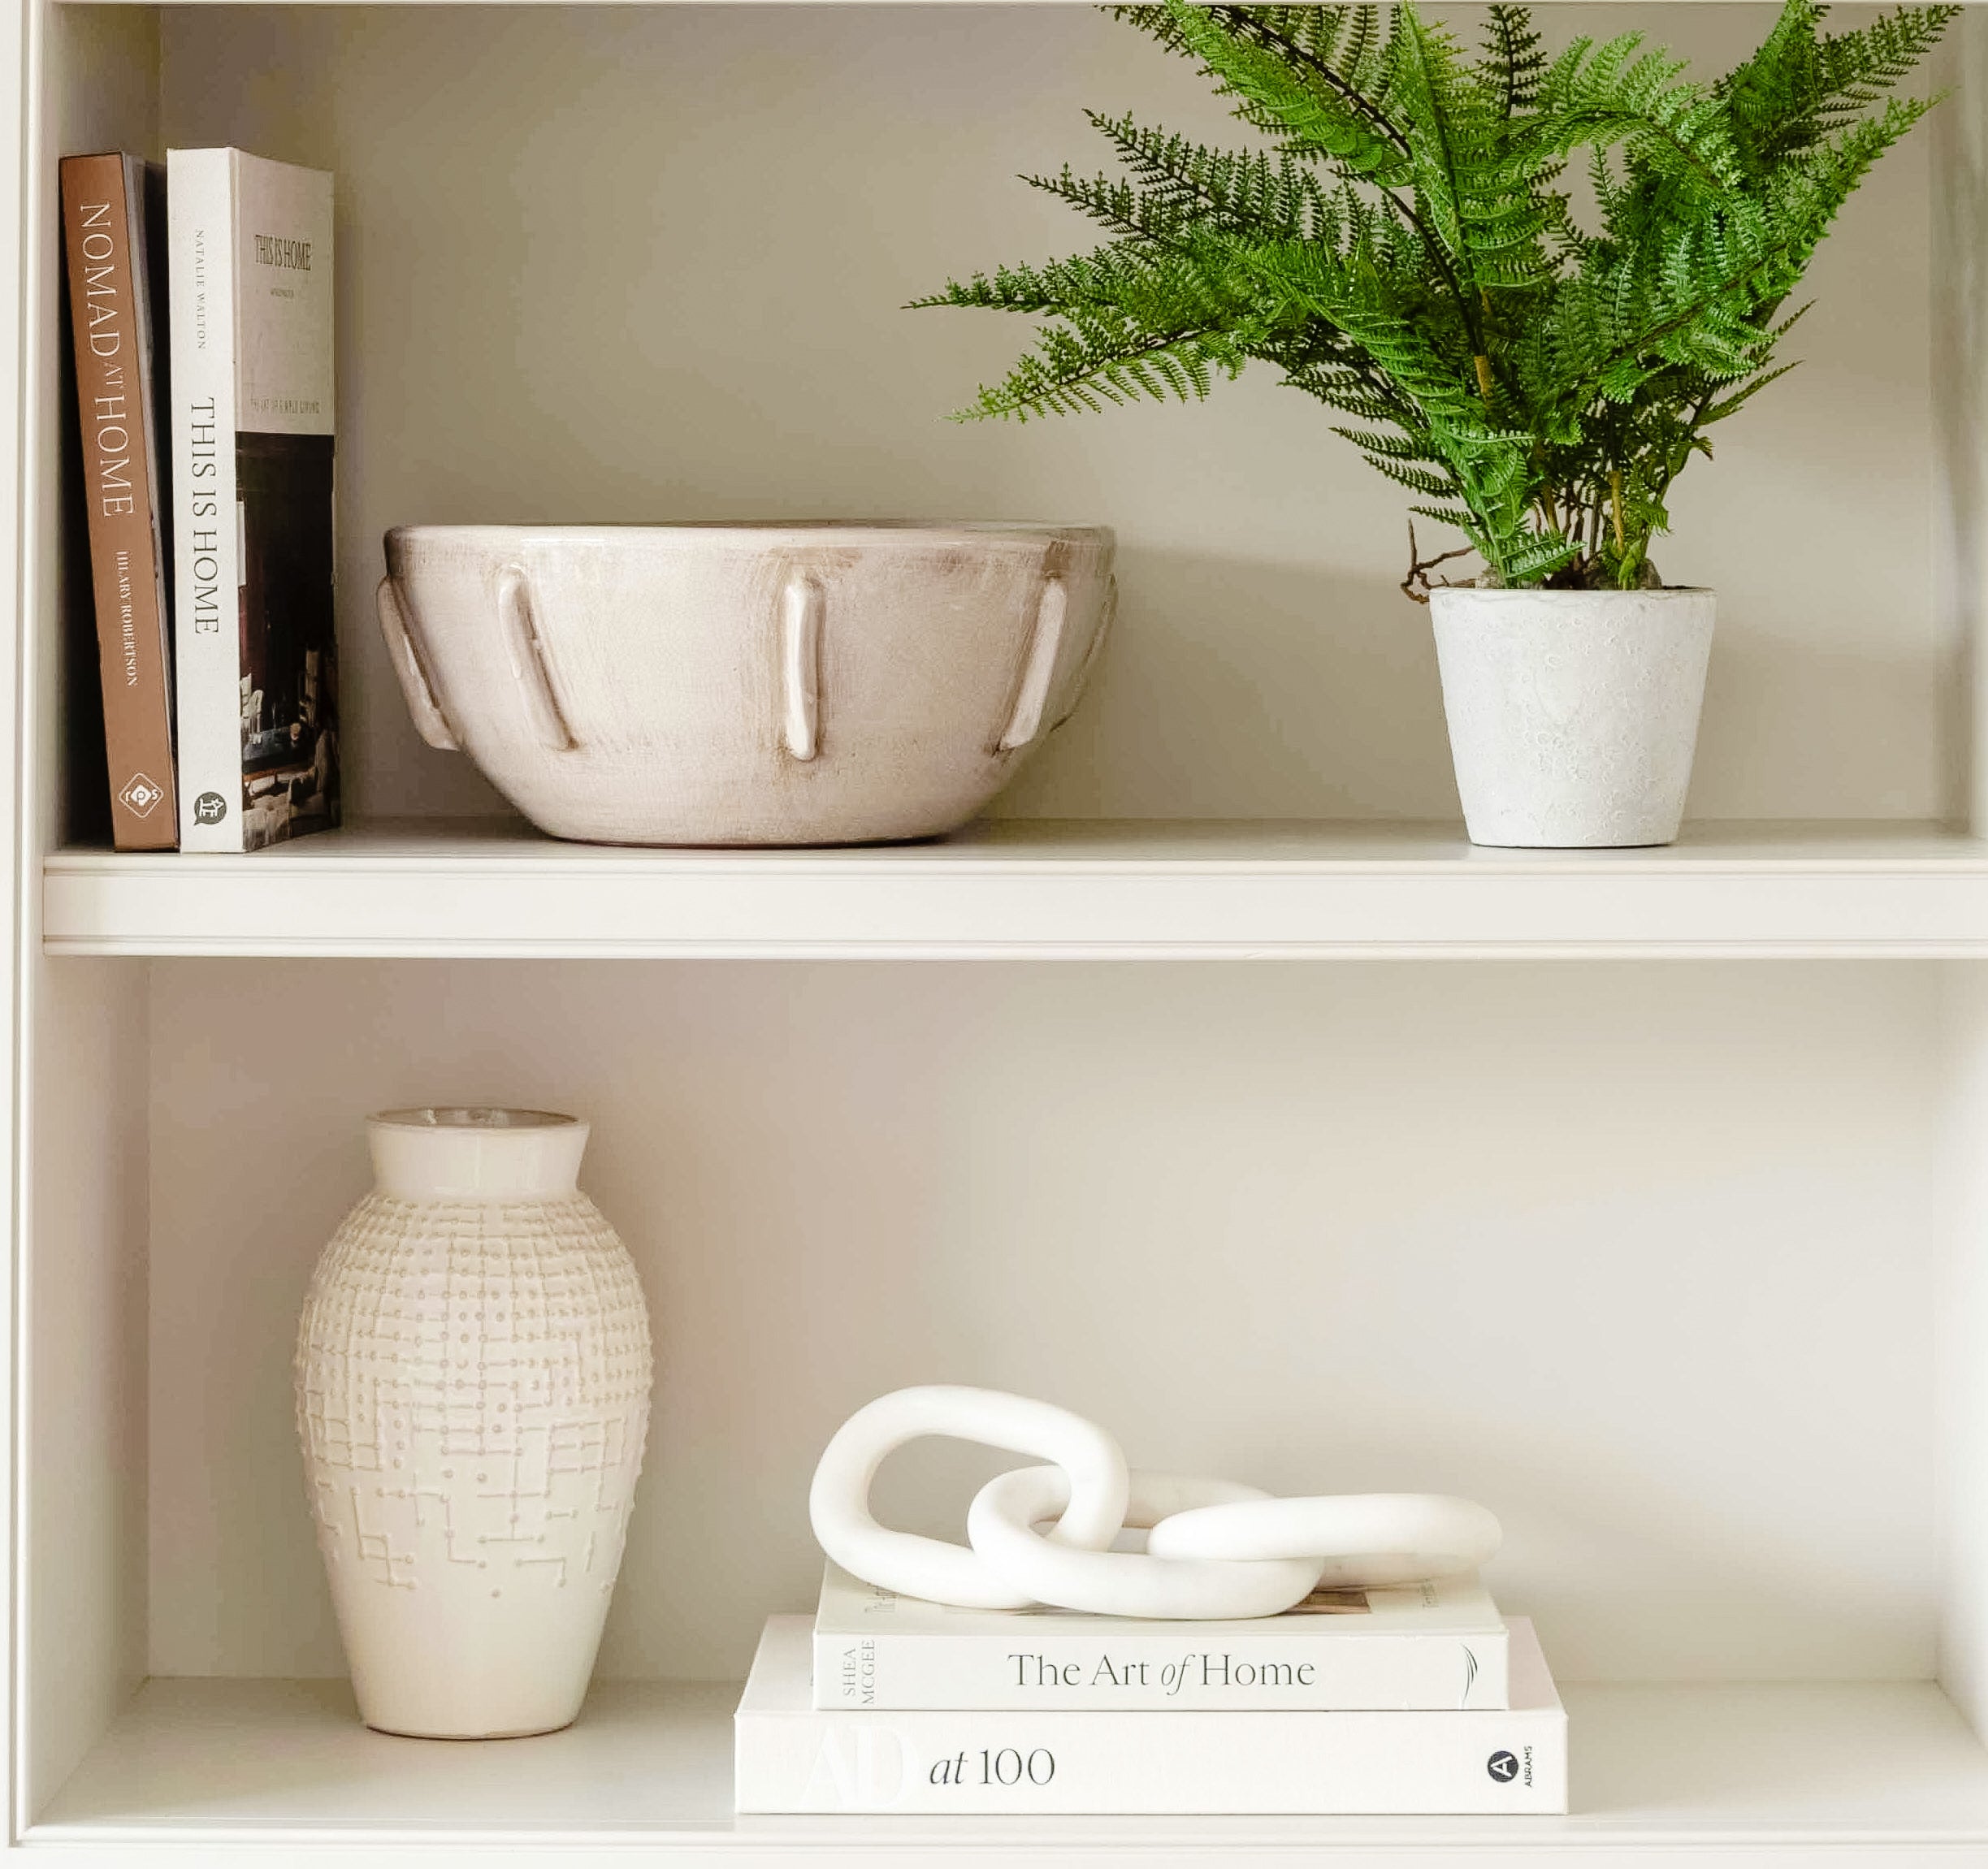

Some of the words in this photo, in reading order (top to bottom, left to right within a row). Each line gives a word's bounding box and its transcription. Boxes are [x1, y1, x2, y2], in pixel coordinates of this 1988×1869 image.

[80, 202, 120, 357] NOMAD
[195, 229, 205, 288] NATALIE
[284, 238, 312, 271] HOME
[197, 292, 206, 349] WALTON
[104, 362, 125, 389] AT
[94, 394, 134, 517] HOME
[190, 396, 216, 478] THIS
[193, 491, 218, 517] IS
[115, 550, 132, 600] HILARY
[193, 530, 219, 634] HOME
[120, 604, 139, 686] ROBERTSON
[842, 1648, 856, 1697] SHEA
[861, 1639, 876, 1705] MCGEE
[1007, 1654, 1081, 1686] The
[1090, 1654, 1150, 1686] Art
[1160, 1654, 1196, 1697] of
[1200, 1654, 1316, 1686] Home
[929, 1751, 968, 1785] at
[979, 1748, 1056, 1786] 100
[1523, 1745, 1534, 1789] ABRAMS
